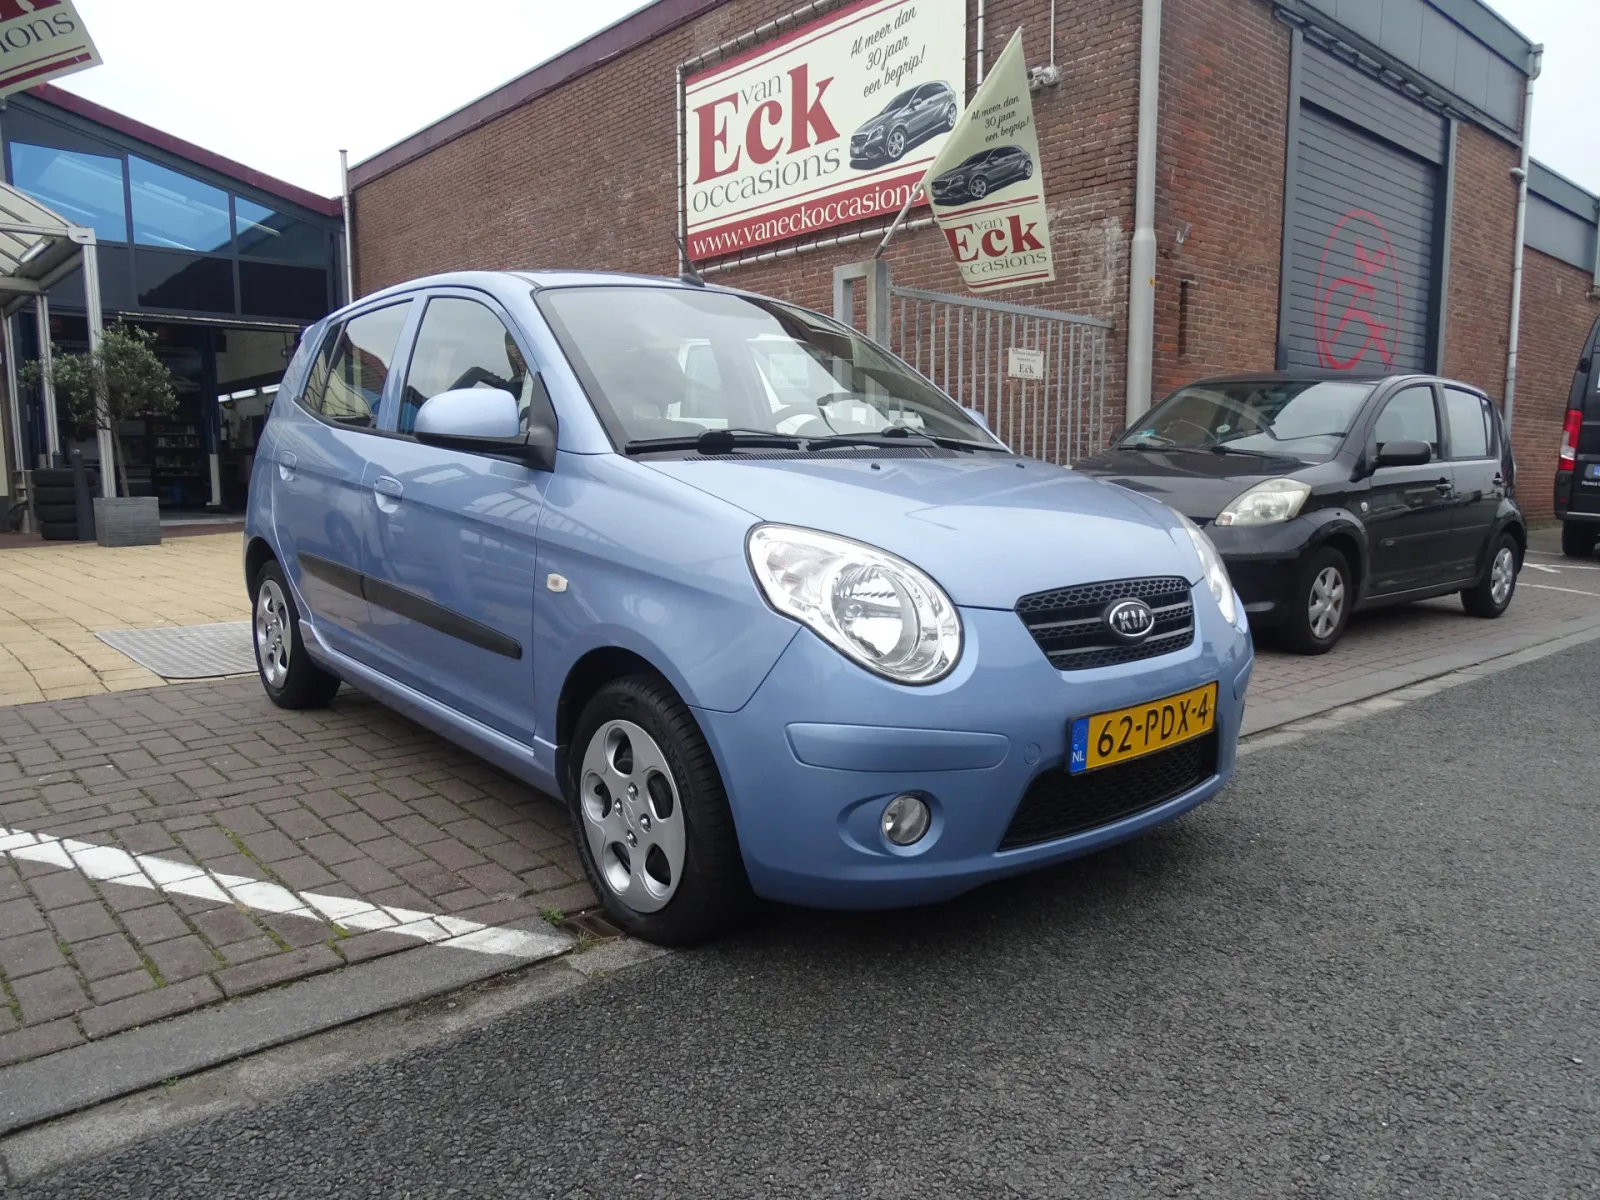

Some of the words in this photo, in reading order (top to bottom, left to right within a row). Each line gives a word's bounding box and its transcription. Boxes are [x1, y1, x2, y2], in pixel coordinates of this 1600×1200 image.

[850, 36, 863, 59] Al
[865, 23, 892, 49] meer
[894, 7, 917, 29] dan
[866, 47, 882, 70] 30
[881, 36, 909, 71] jaar
[863, 79, 882, 97] een
[884, 44, 925, 87] begrip!
[741, 75, 781, 105] van
[971, 110, 981, 121] Al
[982, 103, 1002, 117] meer
[1003, 96, 1020, 107] dan
[985, 116, 997, 129] 30
[997, 110, 1016, 129] jaar
[692, 63, 840, 185] Eck
[985, 132, 999, 143] een
[1001, 115, 1029, 137] begrip!
[693, 148, 840, 212] occasions
[974, 217, 1003, 231] van
[942, 215, 1045, 263] Eck
[961, 252, 1047, 276] ccasions
[1019, 363, 1035, 375] Eck
[1117, 609, 1149, 630] KIA
[1097, 692, 1209, 758] 62-PDX-4
[1072, 750, 1085, 763] NL
